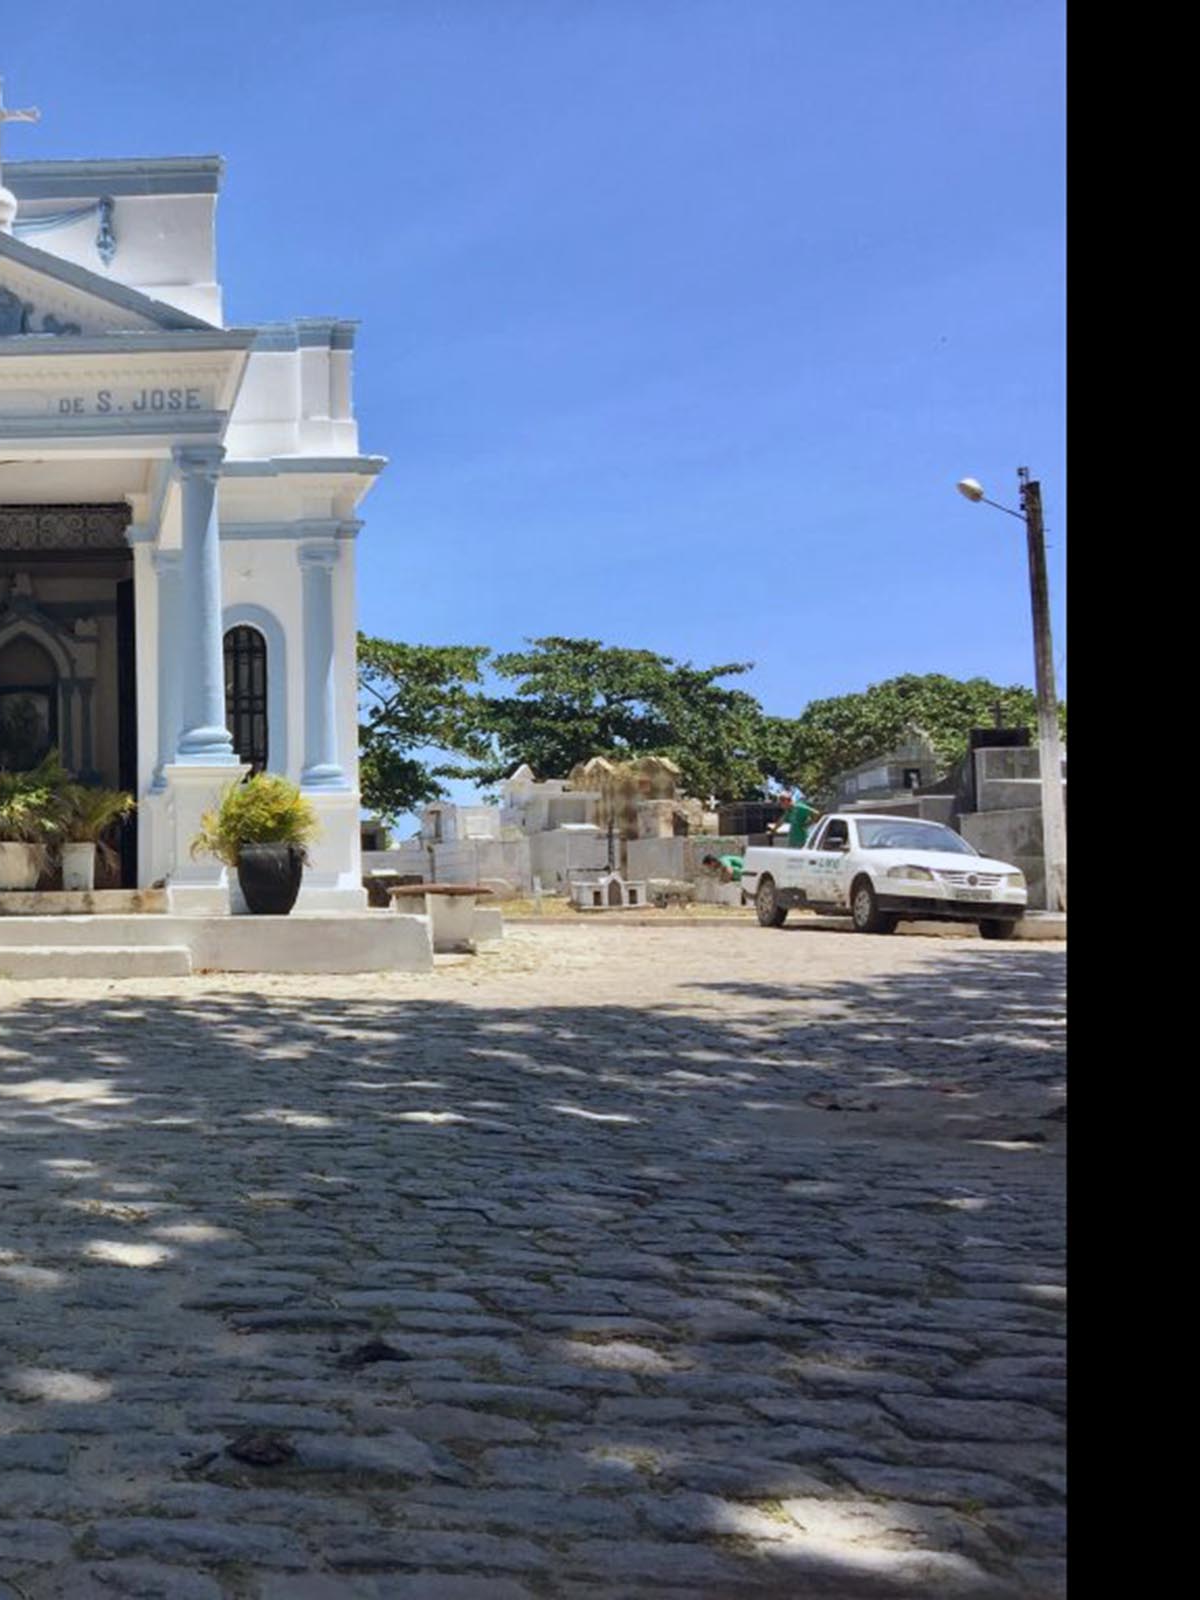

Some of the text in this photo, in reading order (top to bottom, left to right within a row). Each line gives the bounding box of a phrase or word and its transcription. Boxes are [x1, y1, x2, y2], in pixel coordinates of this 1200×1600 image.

[58, 396, 86, 414] DE
[96, 389, 124, 413] S.
[132, 387, 201, 412] JOSE
